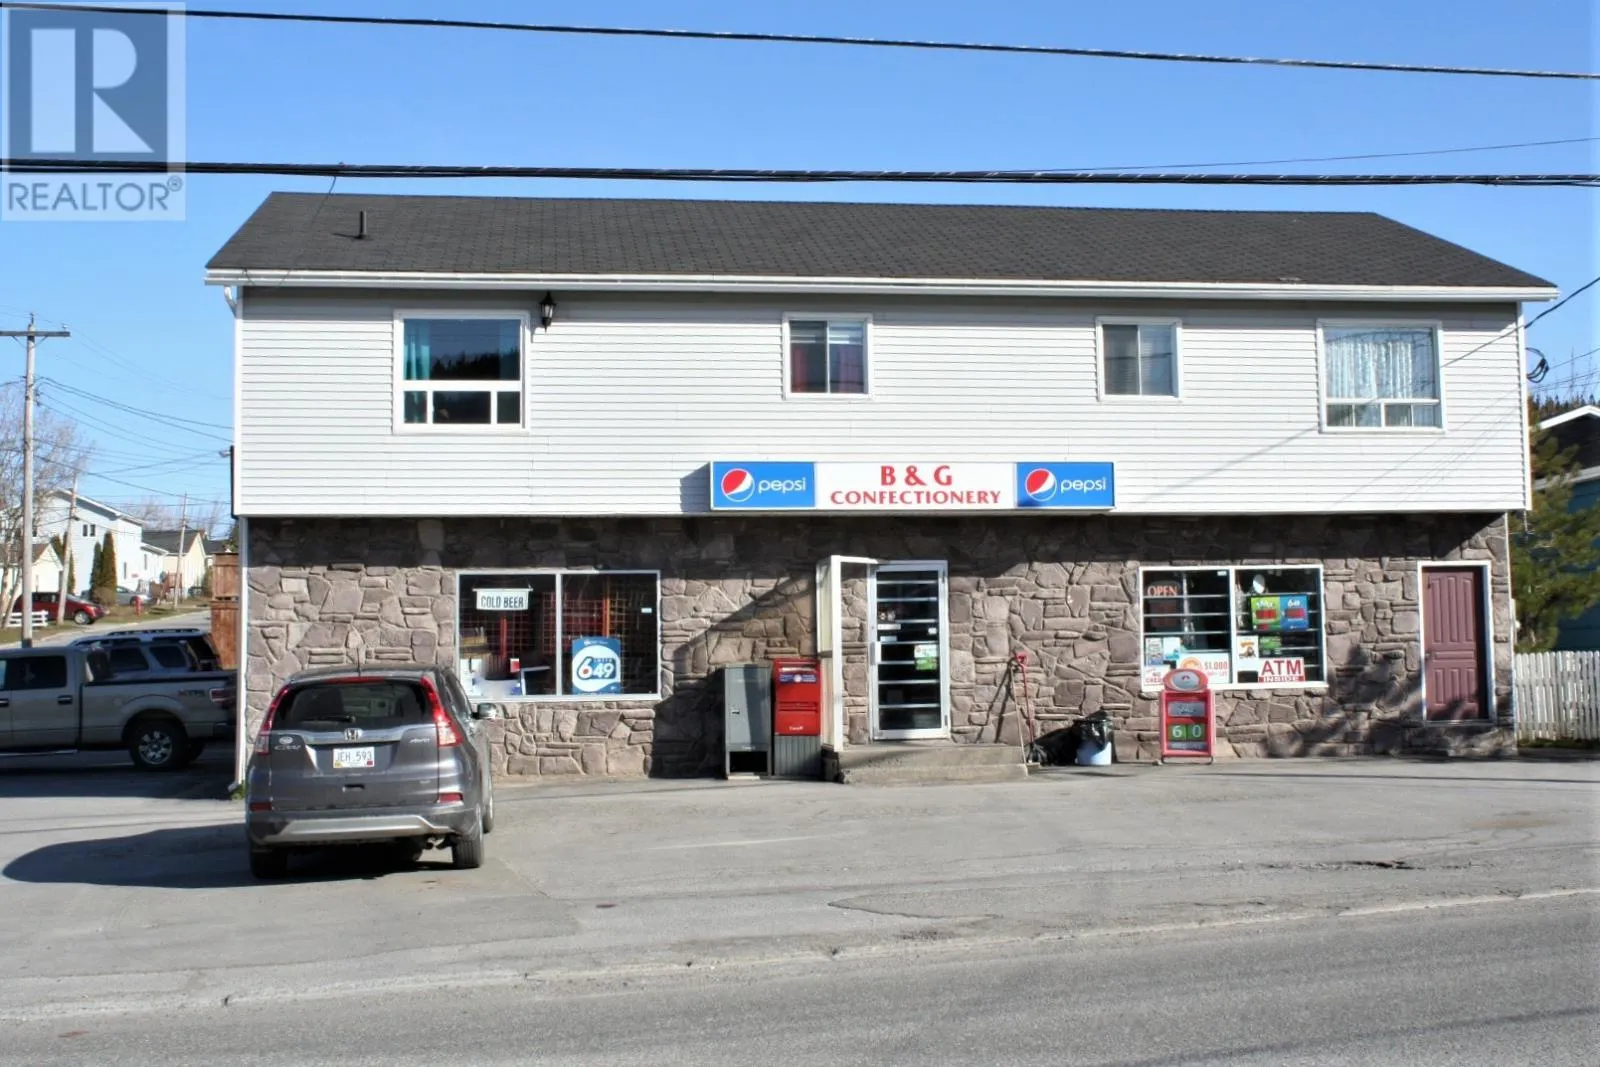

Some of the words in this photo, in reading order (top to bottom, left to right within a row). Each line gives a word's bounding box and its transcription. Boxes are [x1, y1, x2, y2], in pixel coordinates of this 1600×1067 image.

[880, 465, 896, 486] B
[904, 465, 926, 486] &
[933, 465, 953, 486] G
[758, 477, 806, 494] pepsi
[1060, 477, 1106, 494] pepsi
[830, 490, 1001, 505] CONFECTIONERY
[1147, 584, 1178, 596] OPEN
[480, 595, 501, 608] COLD
[503, 596, 524, 608] BEER
[1261, 659, 1303, 675] ATM
